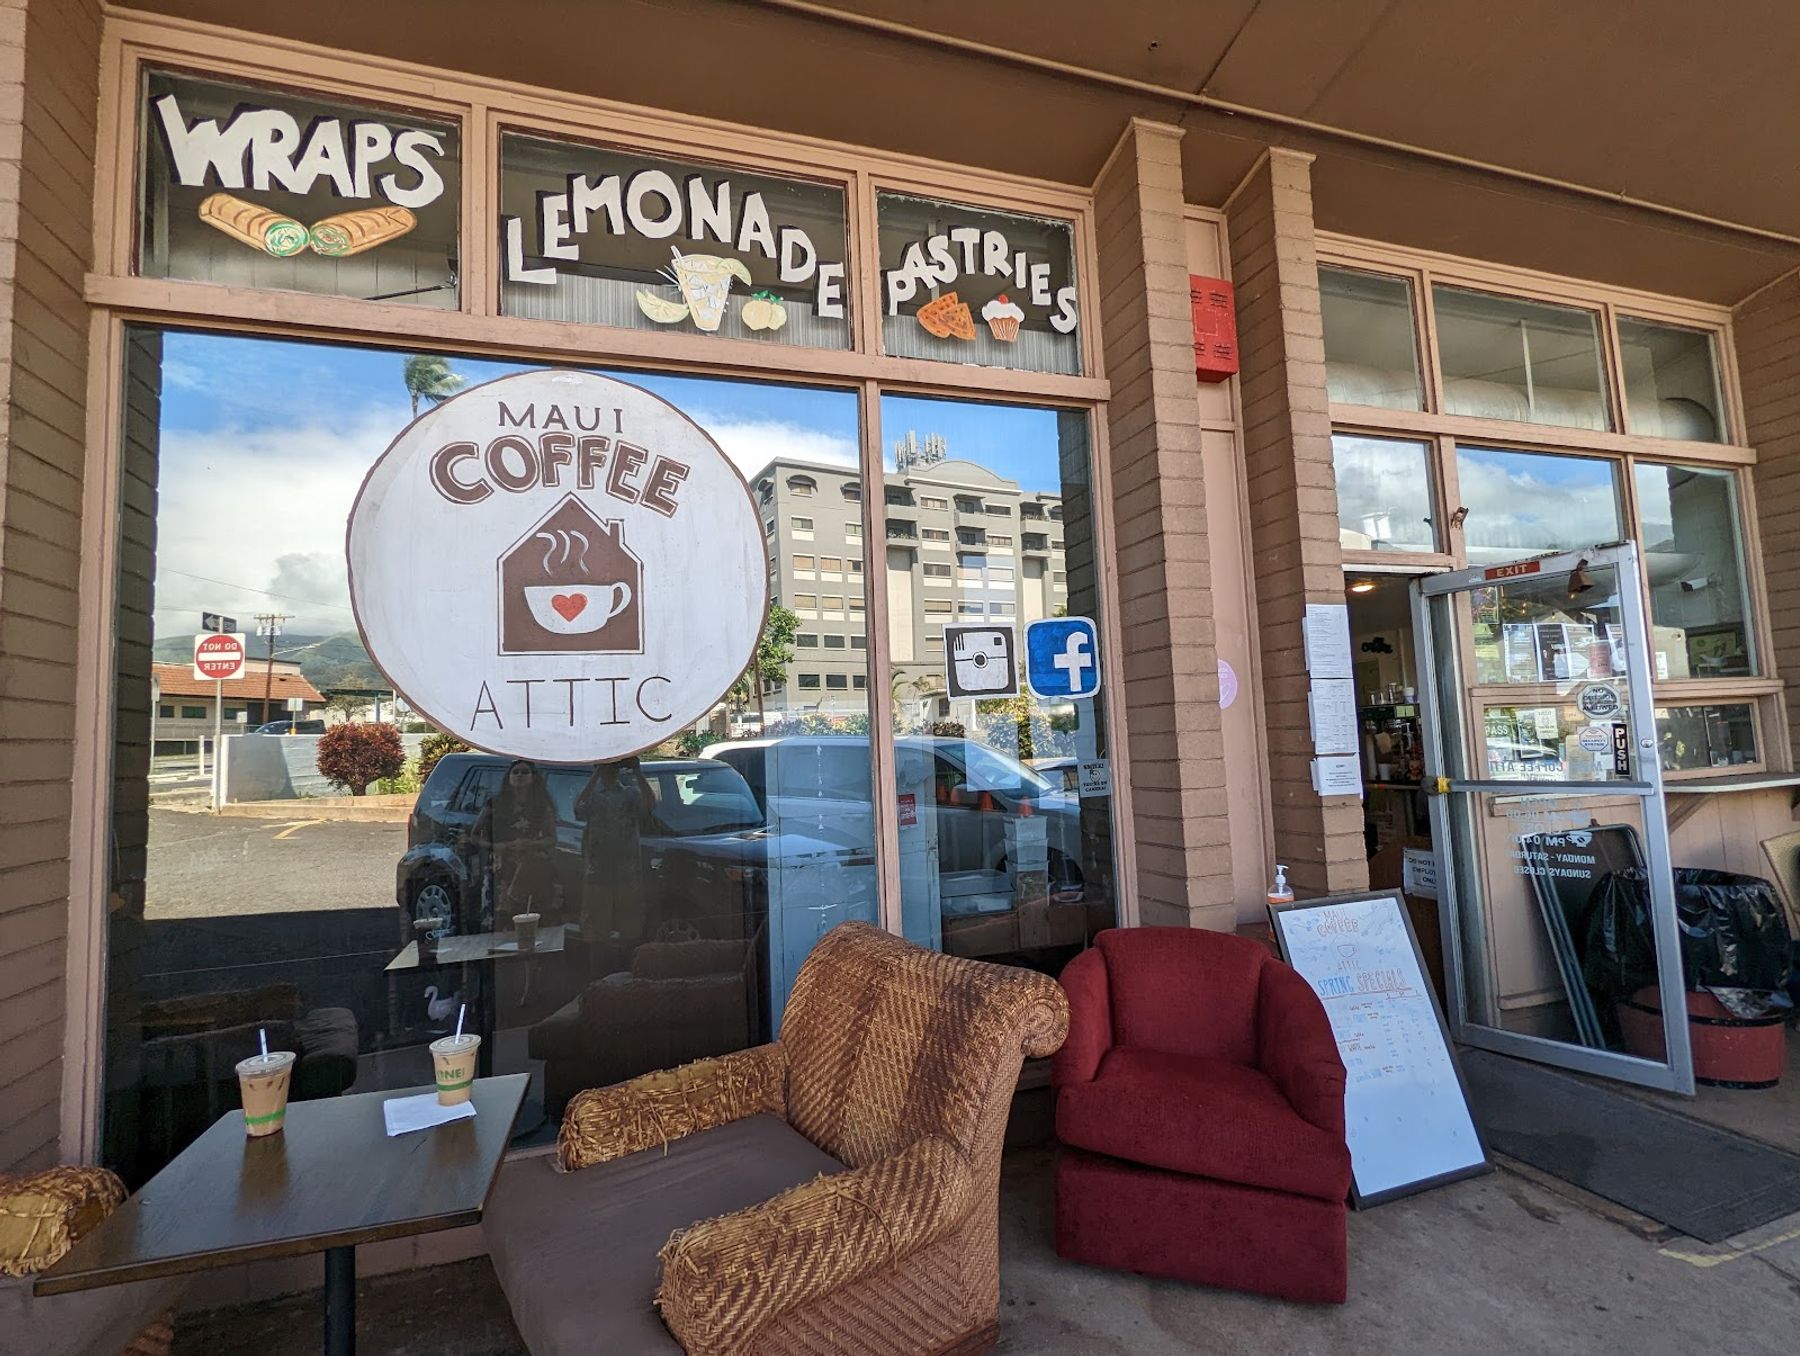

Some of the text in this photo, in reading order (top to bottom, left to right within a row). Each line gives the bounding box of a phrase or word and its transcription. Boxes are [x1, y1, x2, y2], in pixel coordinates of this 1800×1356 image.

[152, 94, 446, 208] WRAPS
[506, 169, 845, 319] LEMONADE
[885, 227, 1078, 334] PASTRIES
[498, 401, 624, 433] MAUI
[429, 432, 690, 518] COFFEE
[1496, 563, 1529, 578] EXIT
[469, 676, 673, 732] ATTIC
[1614, 727, 1628, 771] PUSH
